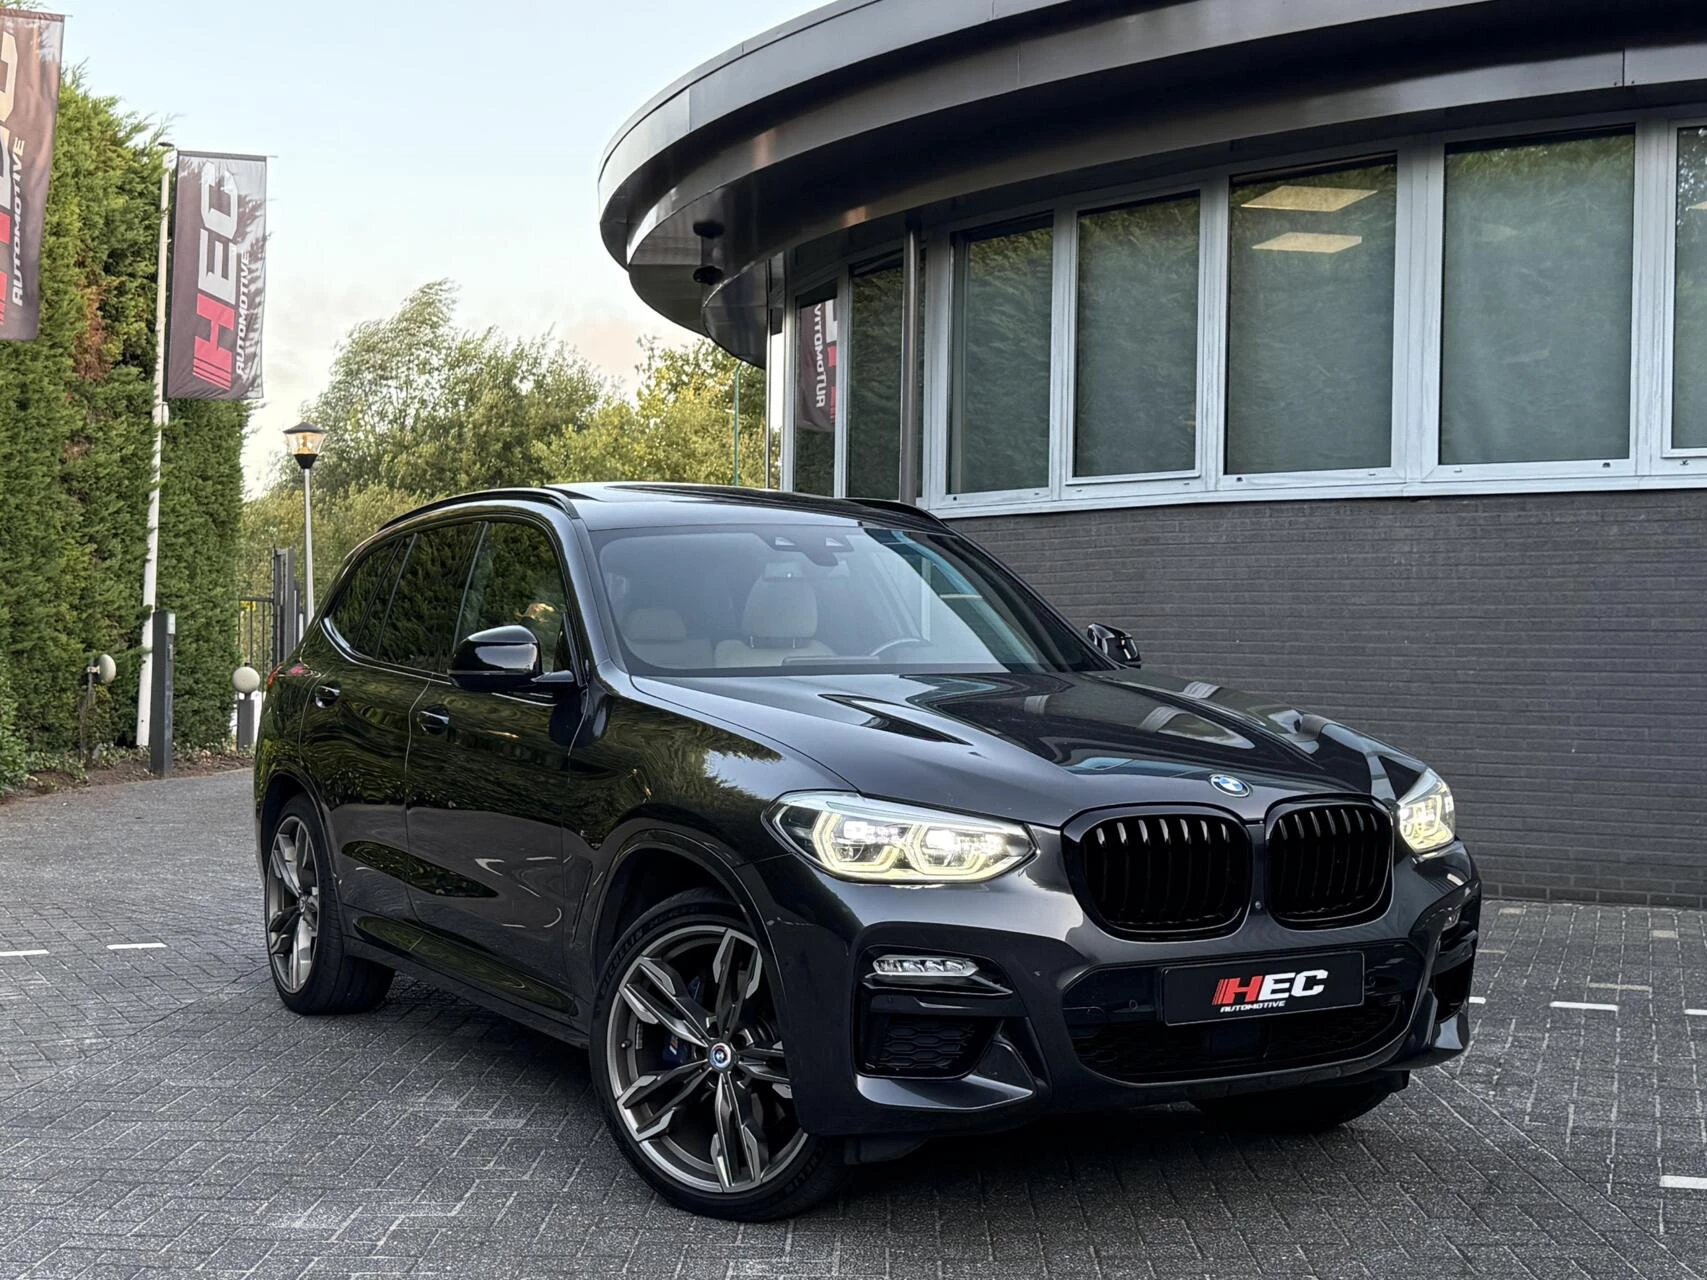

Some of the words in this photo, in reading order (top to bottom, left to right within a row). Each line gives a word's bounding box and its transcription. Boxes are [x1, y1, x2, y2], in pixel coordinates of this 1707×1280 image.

[12, 137, 25, 307] AUTOMOTIVE
[192, 160, 238, 390] HEC
[236, 250, 250, 375] AUTOMOTIVE
[1212, 969, 1329, 1006] HEC
[1220, 1000, 1286, 1013] AUTOMOTIVE
